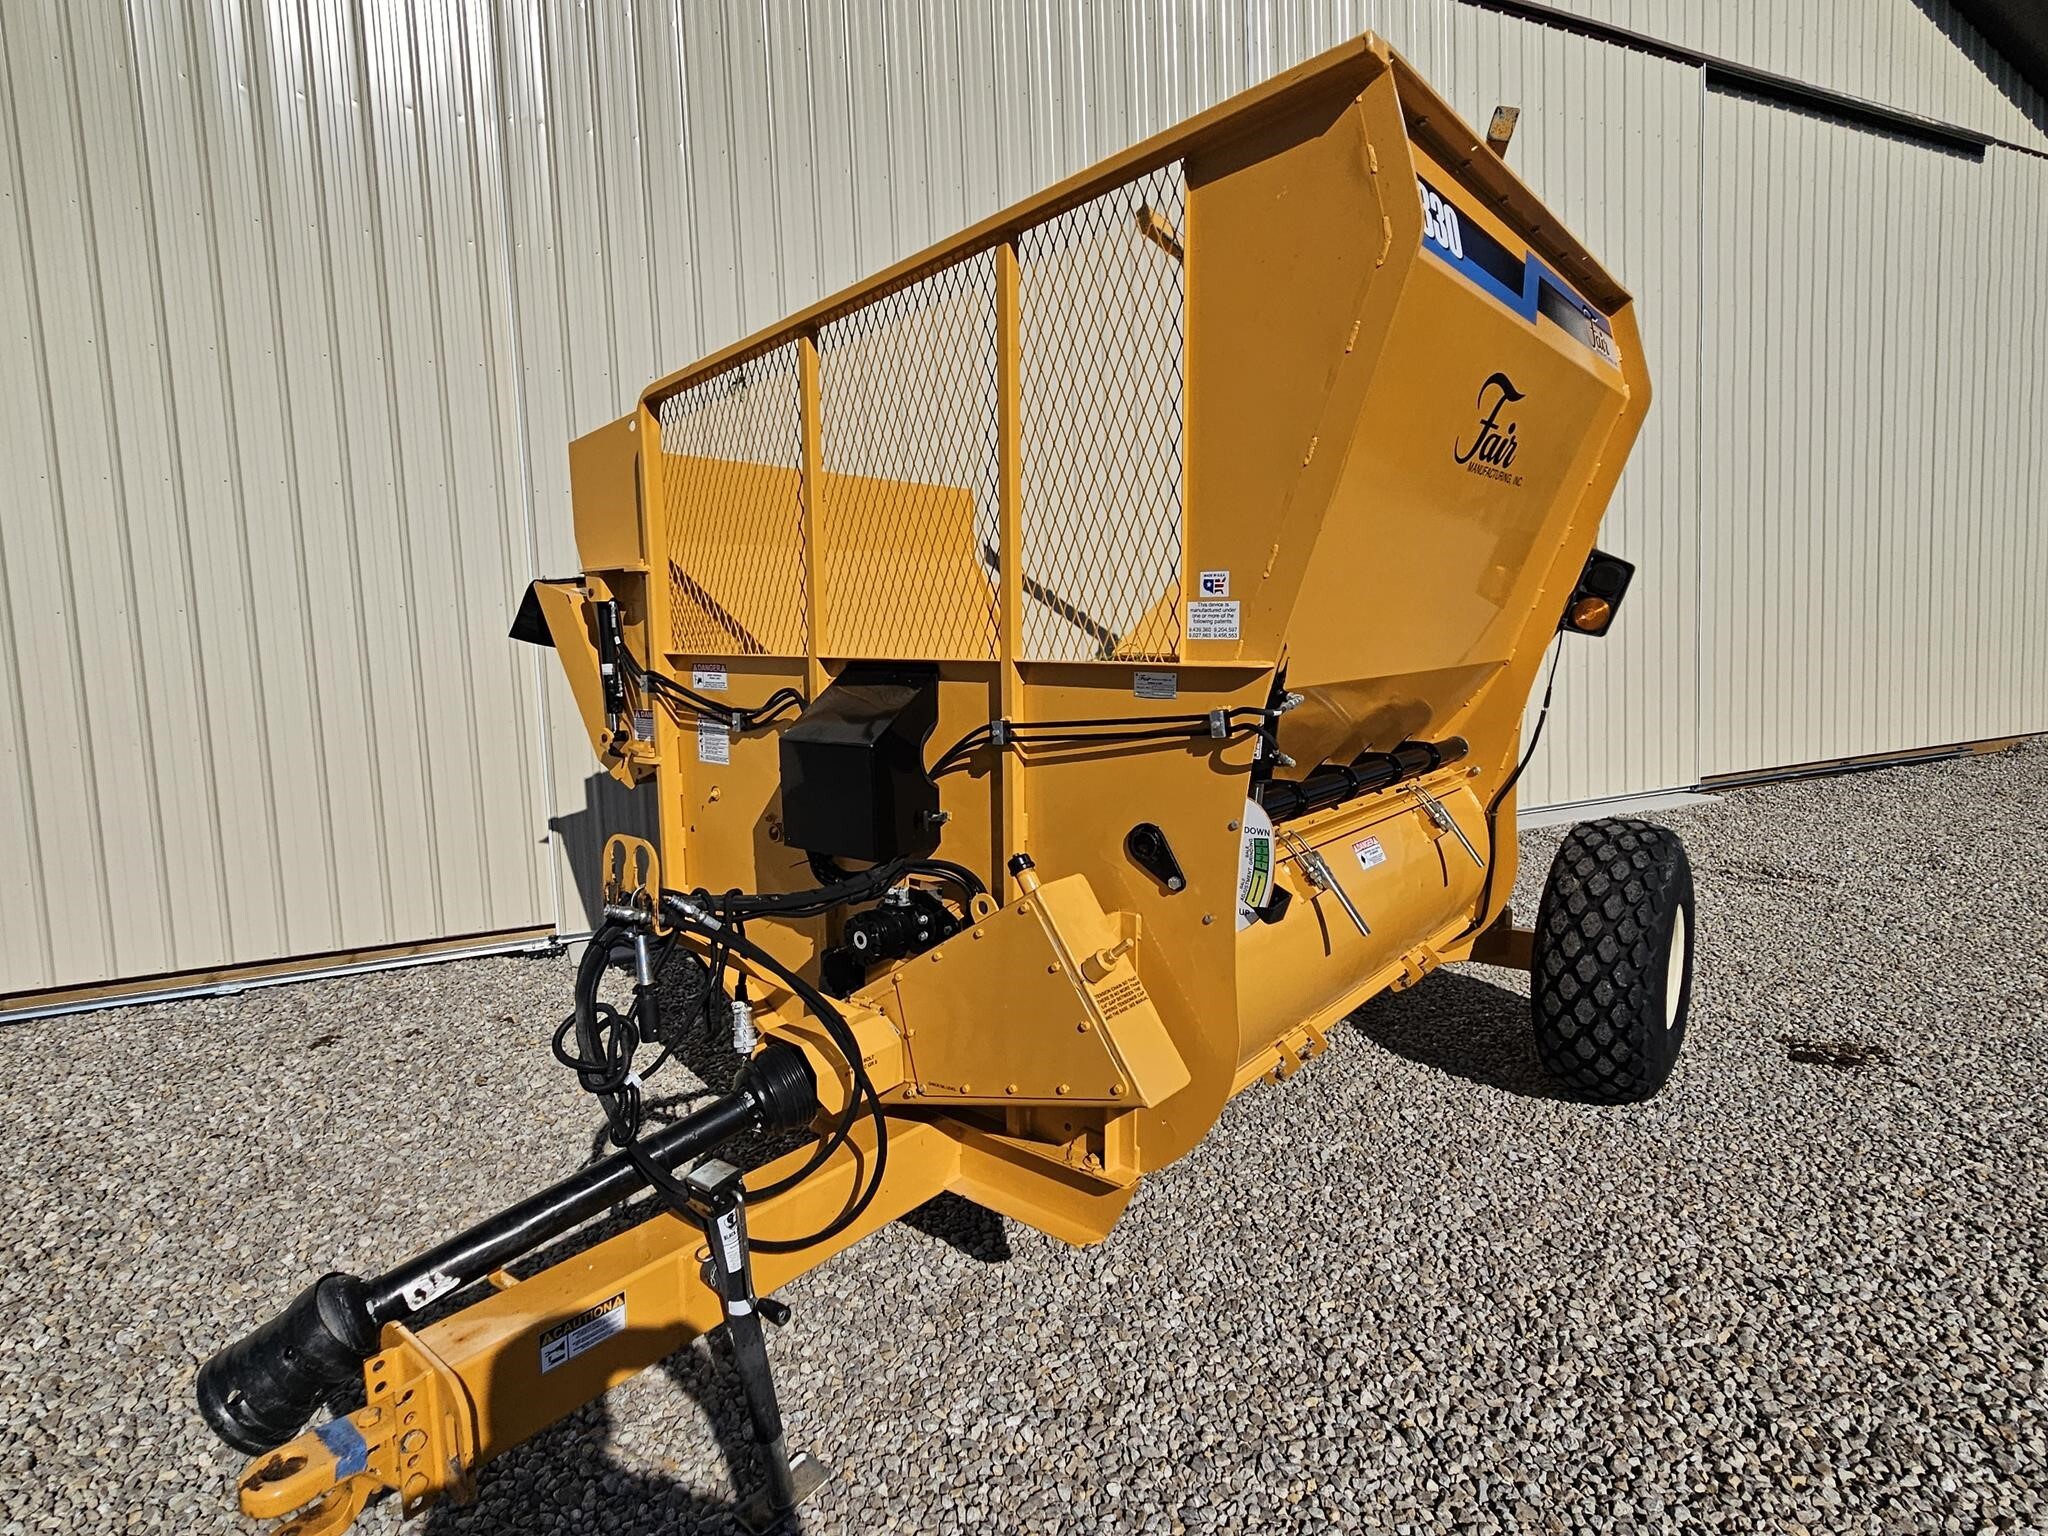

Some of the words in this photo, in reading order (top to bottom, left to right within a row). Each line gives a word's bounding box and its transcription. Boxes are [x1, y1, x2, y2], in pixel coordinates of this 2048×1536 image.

[1582, 304, 1610, 356] Fair
[1454, 372, 1526, 469] Fair
[697, 664, 721, 672] DANGER
[1243, 826, 1271, 837] DOWN
[1240, 867, 1253, 902] ADJUSTMENT
[1238, 908, 1251, 916] UP
[1094, 989, 1111, 998] TENSION
[1111, 983, 1122, 992] CHAIN
[1096, 996, 1110, 1004] THERE
[1119, 985, 1131, 993] MORE
[1108, 998, 1117, 1006] GAP
[1116, 990, 1134, 1001] BETWEEN
[1103, 1005, 1118, 1015] SPRING
[1117, 994, 1137, 1007] TENSIONER
[1136, 990, 1145, 998] CAP
[552, 1300, 613, 1339] CAUTION
